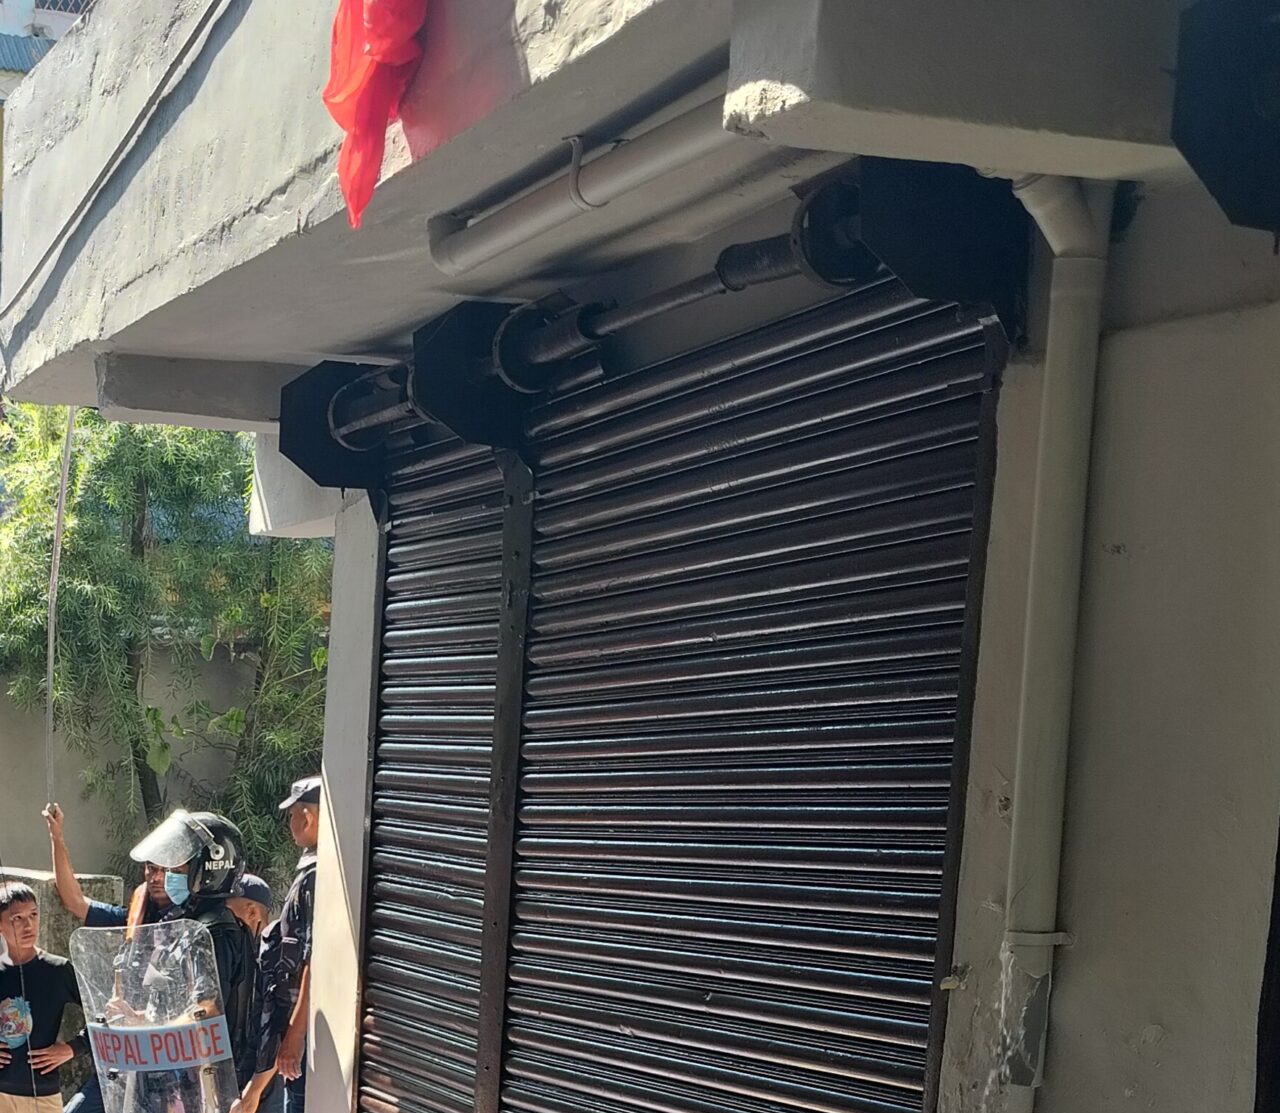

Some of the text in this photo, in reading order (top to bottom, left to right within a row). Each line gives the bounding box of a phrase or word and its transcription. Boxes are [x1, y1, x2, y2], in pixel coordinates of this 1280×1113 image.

[205, 860, 235, 870] NEPAL
[92, 1023, 224, 1065] NEPAL POLICE
